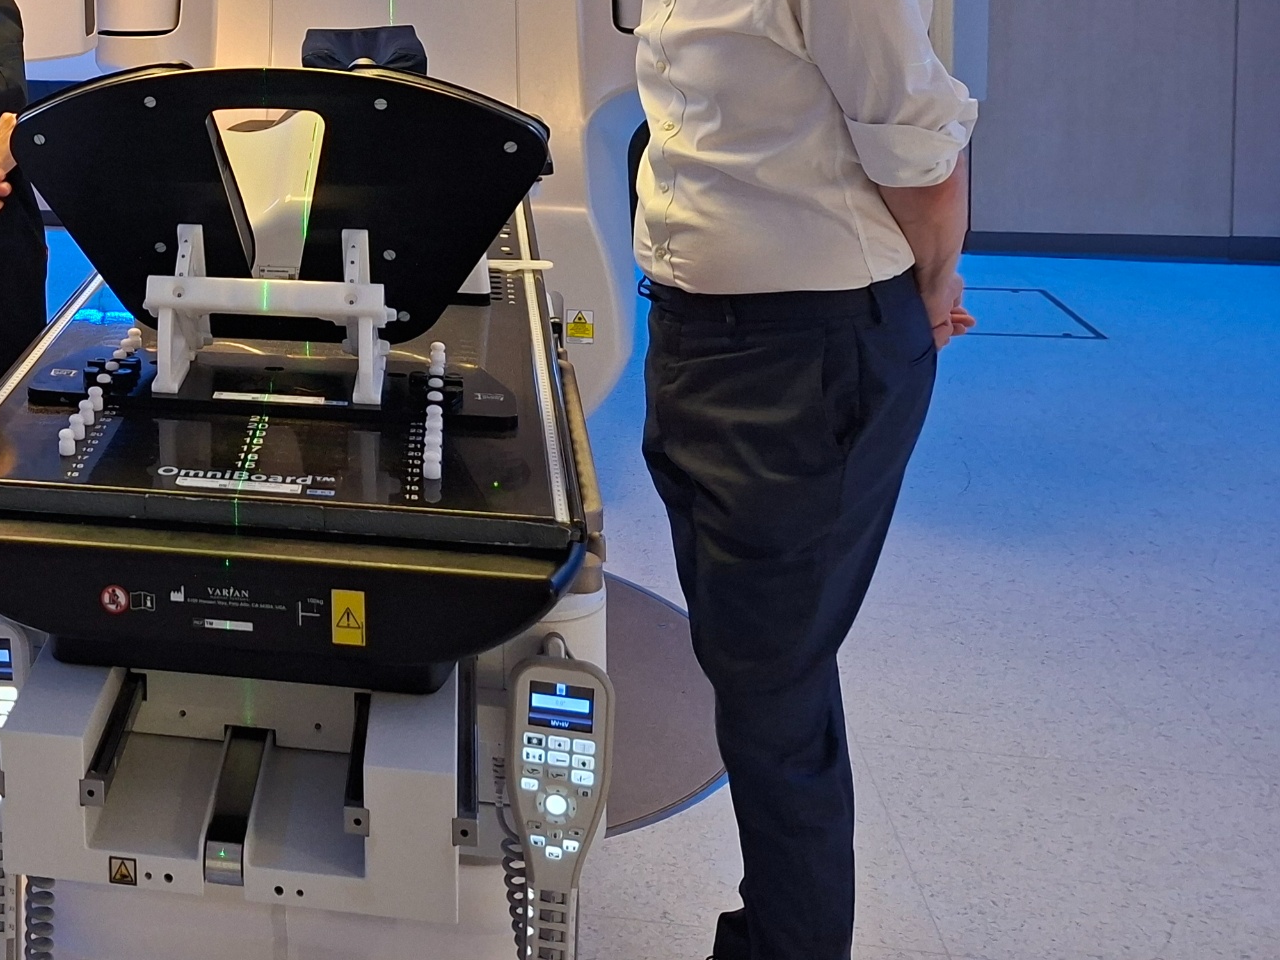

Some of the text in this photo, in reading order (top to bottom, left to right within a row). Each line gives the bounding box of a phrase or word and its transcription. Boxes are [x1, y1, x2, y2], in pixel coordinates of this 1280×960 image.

[244, 437, 264, 445] 18
[235, 461, 256, 469] 15
[207, 586, 249, 598] VARIAN
